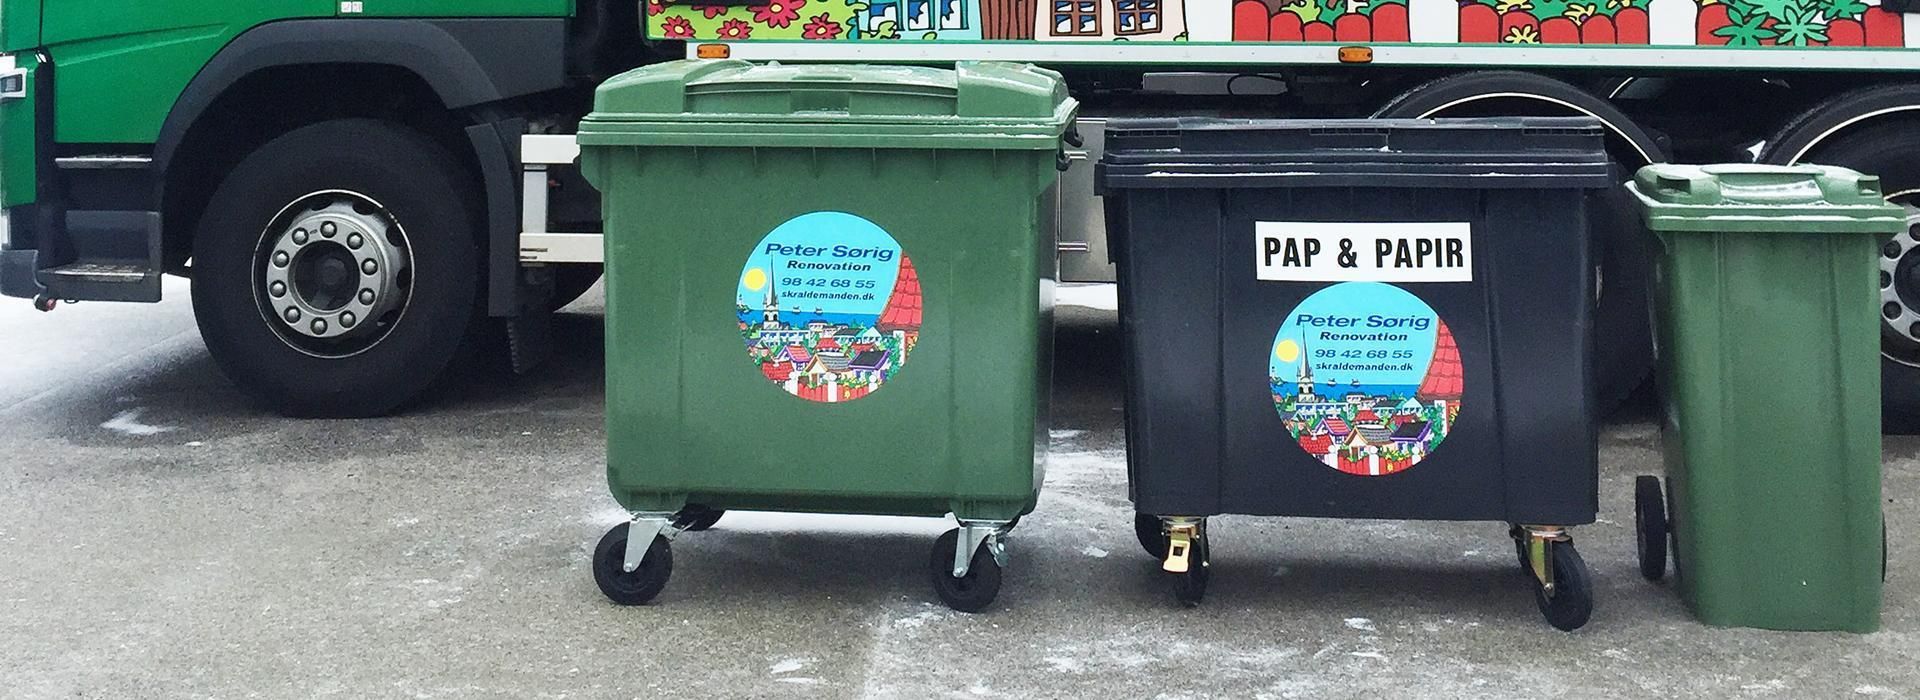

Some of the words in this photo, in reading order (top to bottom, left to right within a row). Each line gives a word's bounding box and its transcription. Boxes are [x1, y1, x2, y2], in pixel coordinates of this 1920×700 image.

[765, 243, 828, 257] Peter
[832, 245, 893, 262] Sørig
[1264, 237, 1321, 268] PAP
[1337, 238, 1358, 268] &
[1375, 238, 1463, 268] PAPIR
[787, 260, 871, 271] Renovation
[782, 277, 801, 287] 98
[806, 278, 826, 287] 42
[830, 279, 850, 288] 68
[855, 279, 875, 289] 55
[782, 290, 874, 301] skraldemanden.dk
[1296, 314, 1361, 327] Peter
[1366, 315, 1430, 330] Sørig
[1320, 331, 1407, 341] Renovation
[1315, 349, 1336, 359] 98
[1340, 350, 1362, 359] 42
[1366, 350, 1387, 359] 68
[1392, 350, 1413, 359] 55
[1315, 362, 1413, 371] skraldemanden.dk
